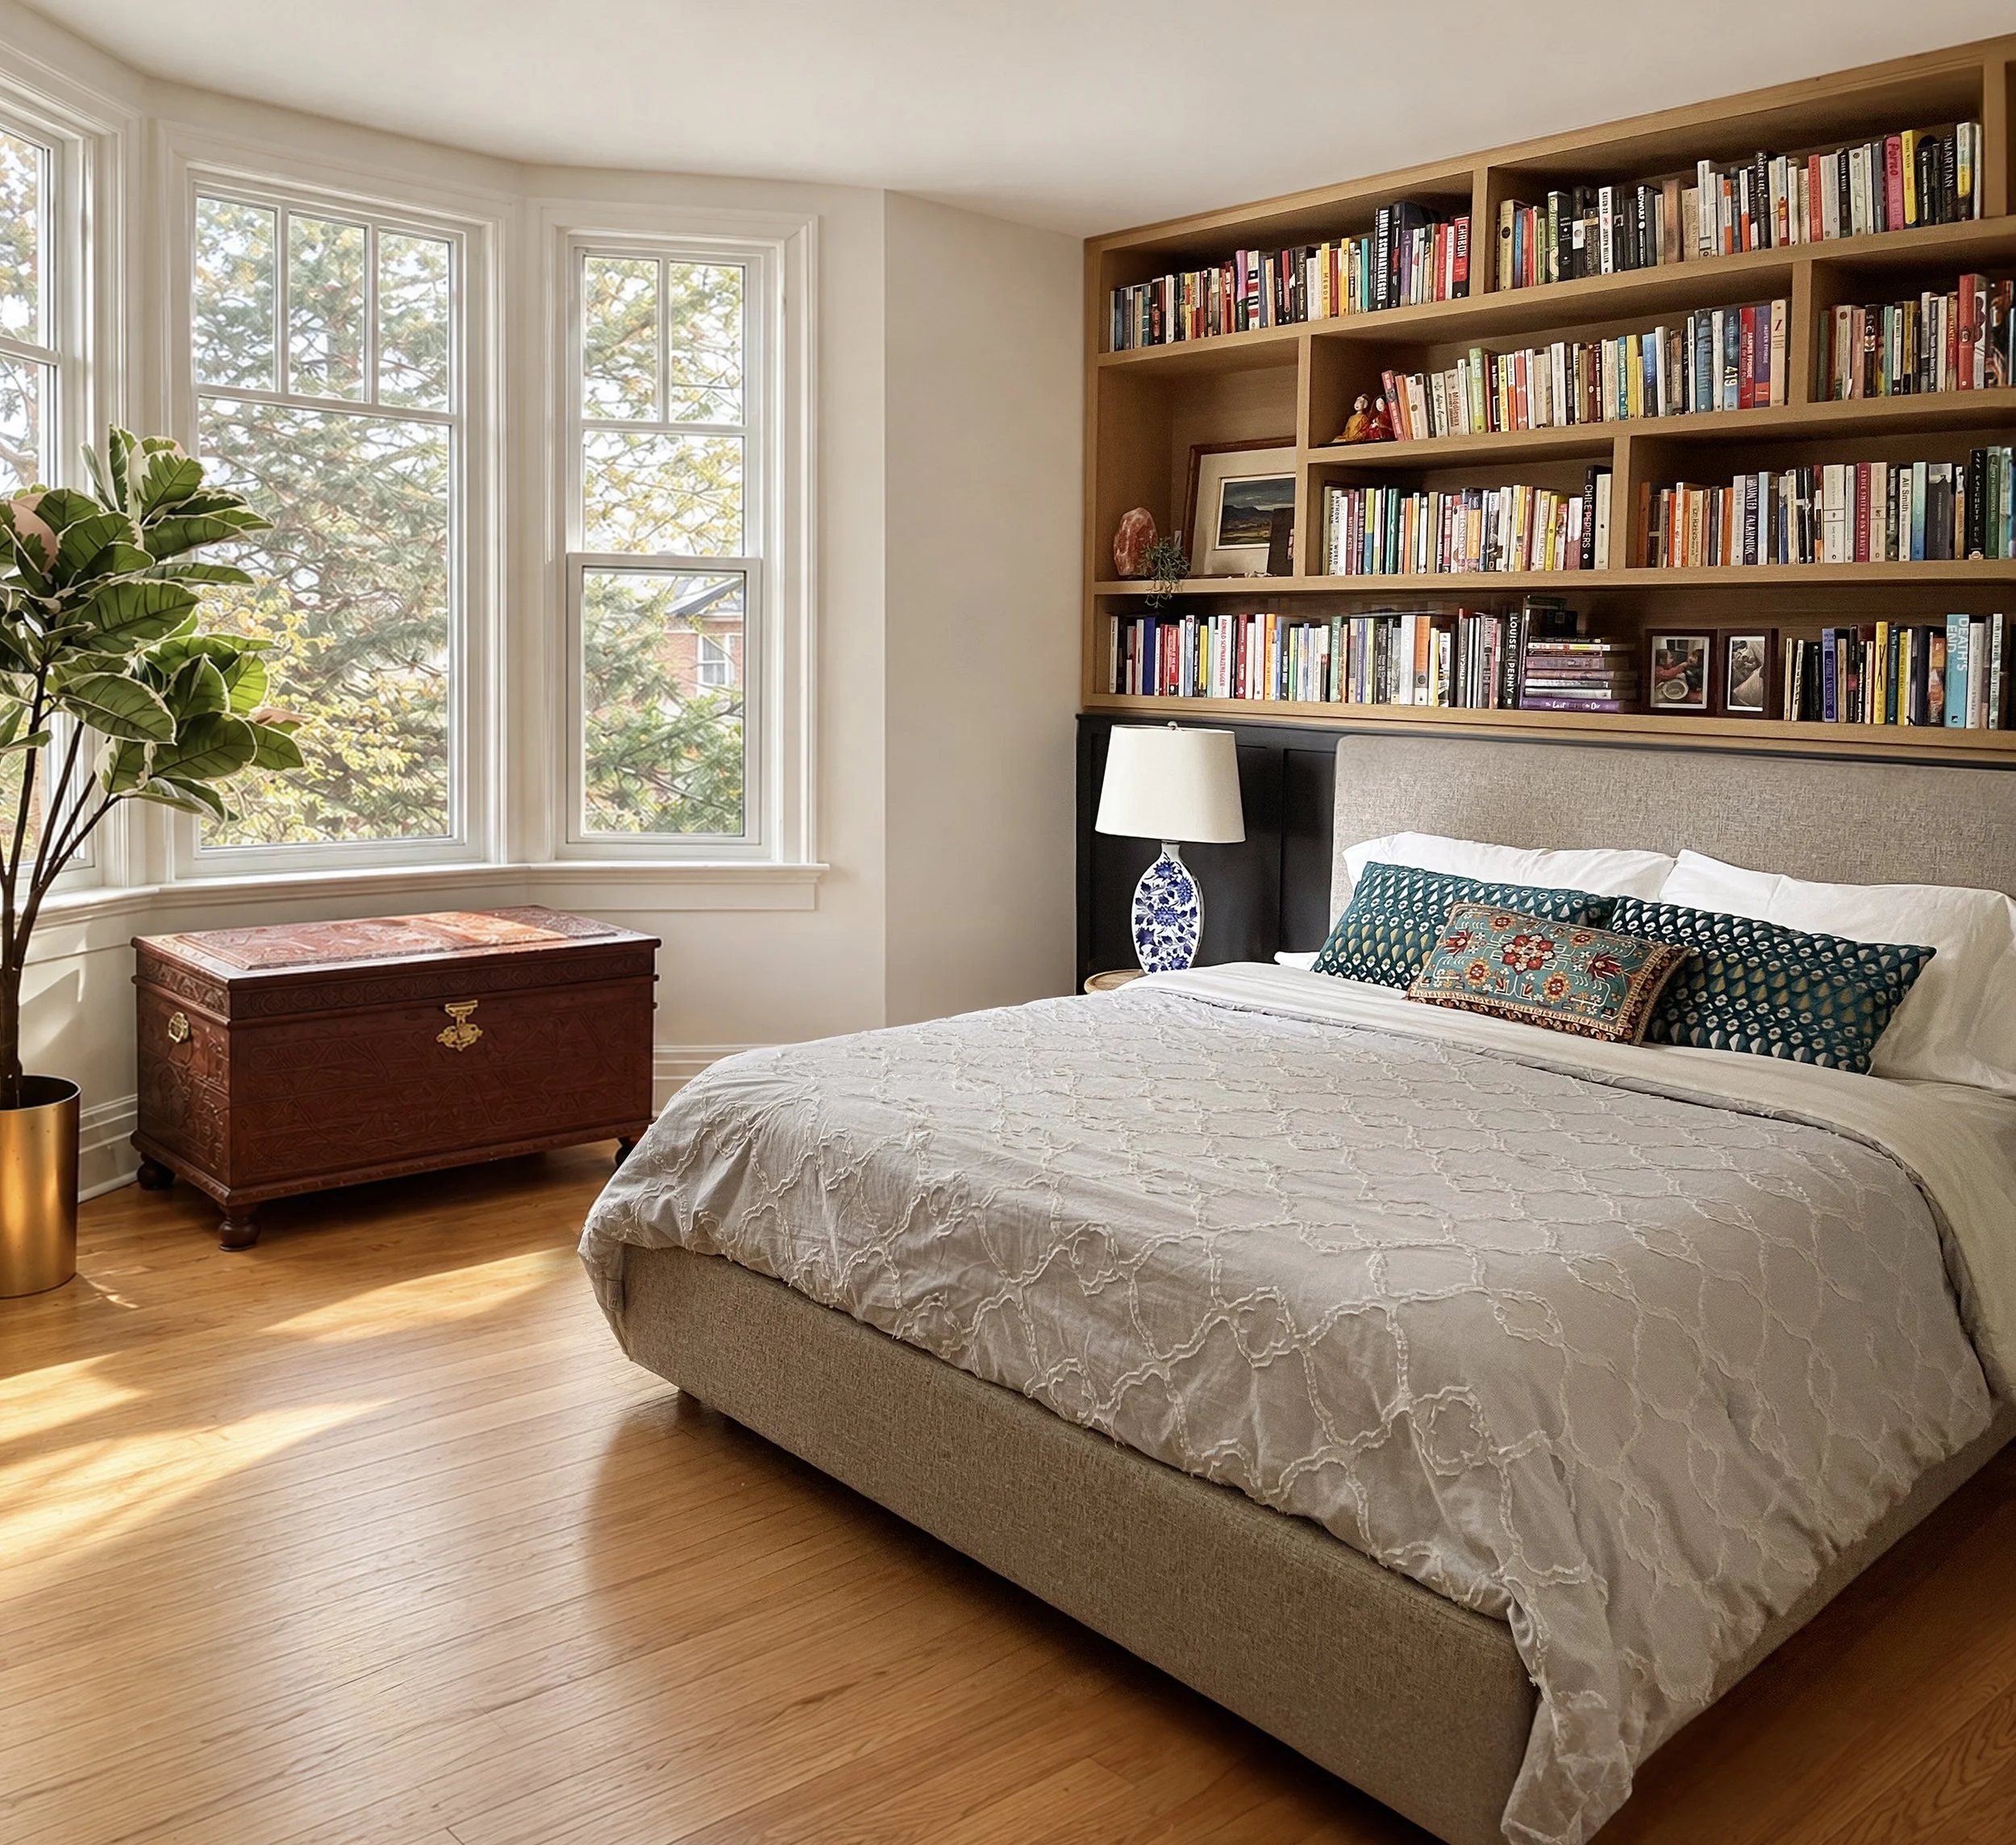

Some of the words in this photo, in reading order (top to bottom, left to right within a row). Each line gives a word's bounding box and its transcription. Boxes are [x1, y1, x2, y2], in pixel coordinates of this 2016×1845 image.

[1757, 152, 1765, 177] HARPER
[1888, 143, 1901, 177] Porno
[1944, 142, 1954, 188] MARTIAN
[1637, 185, 1645, 219] BEOWULF
[1378, 210, 1389, 237] ARNOLD
[1456, 223, 1468, 257] CHABON
[1297, 264, 1305, 285] Darling
[1377, 238, 1388, 301] SCHWARZENEGGER
[1673, 364, 1681, 402] Neverwhere
[1723, 365, 1739, 388] 419
[1452, 391, 1460, 427] Middlesex
[1584, 484, 1593, 510] CHILE
[1746, 478, 1757, 510] HAUNTED
[1901, 477, 1910, 487] Ali
[1901, 489, 1910, 512] Smith
[1744, 514, 1756, 555] PALAHNIUK
[1508, 616, 1518, 650] LOUISE
[1947, 624, 1958, 653] END
[1956, 617, 1969, 672] DEATH'S
[1506, 662, 1515, 694] PENNY
